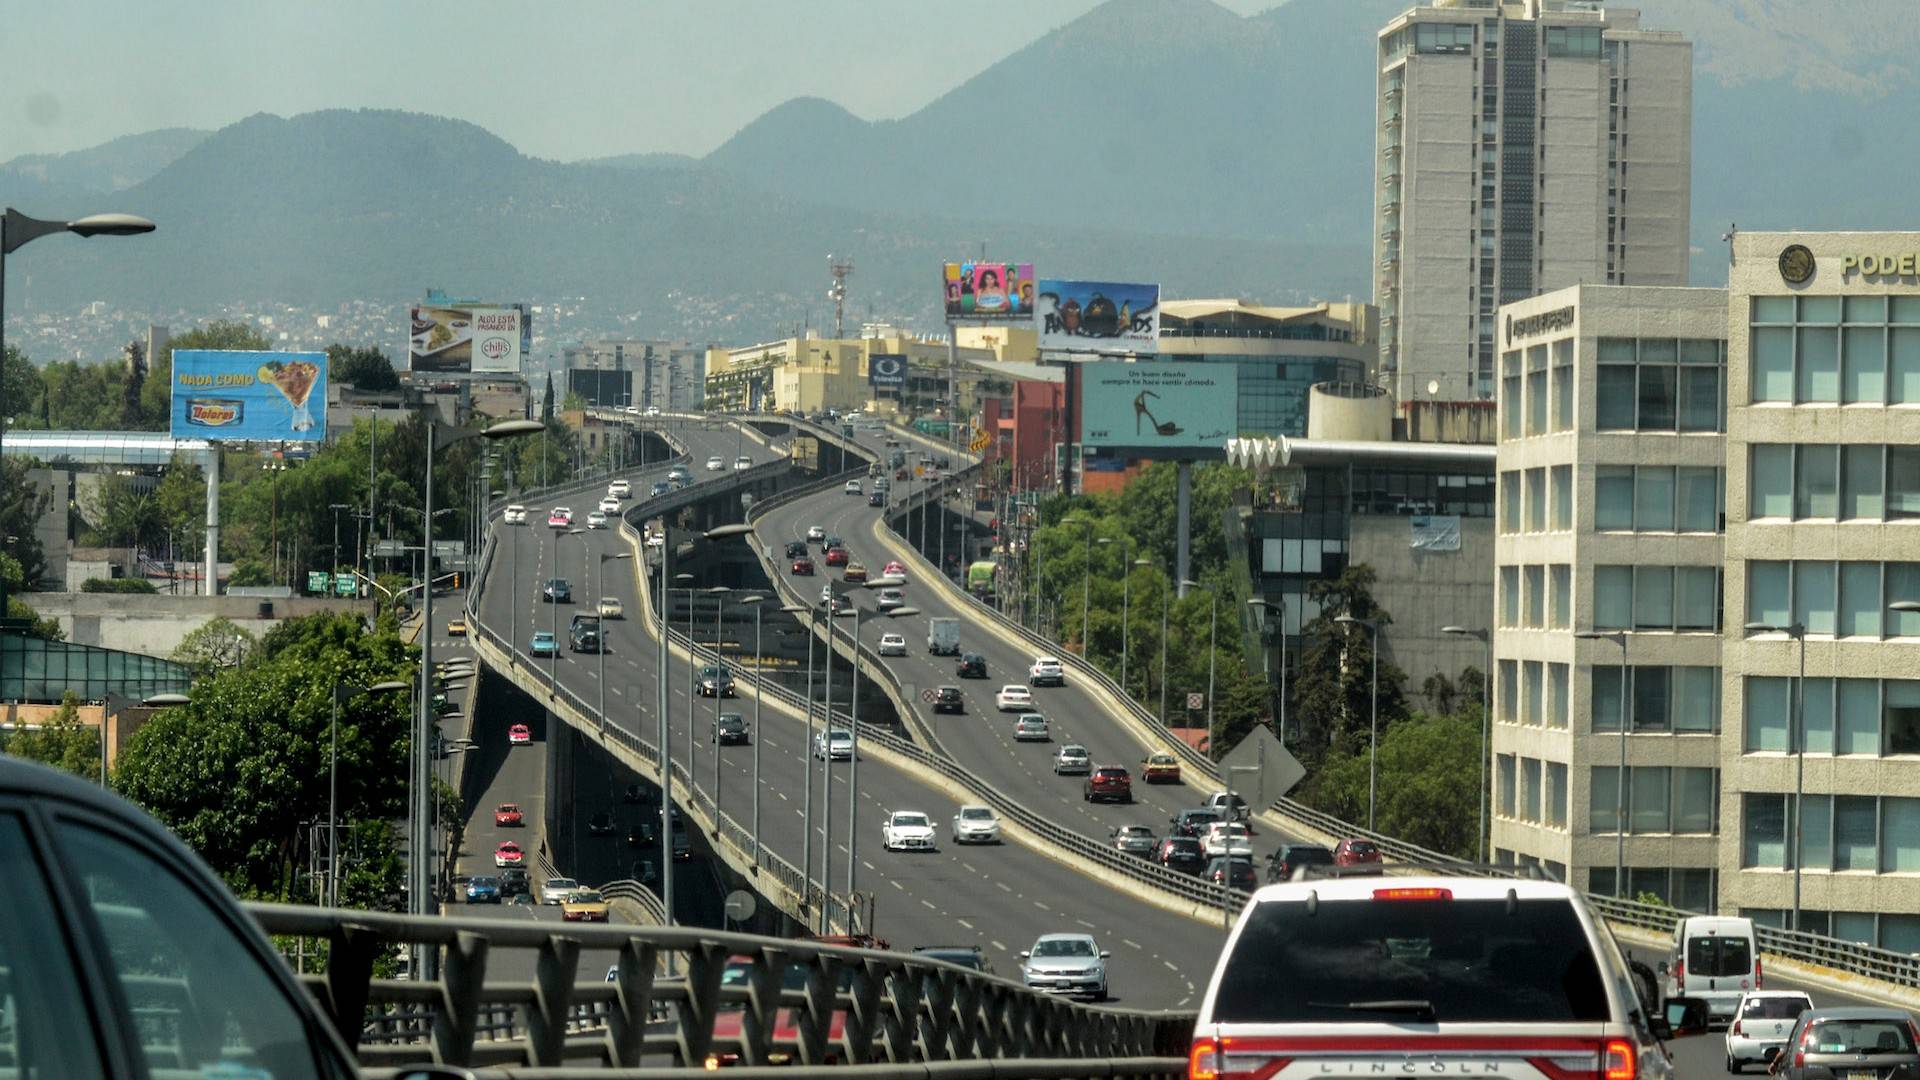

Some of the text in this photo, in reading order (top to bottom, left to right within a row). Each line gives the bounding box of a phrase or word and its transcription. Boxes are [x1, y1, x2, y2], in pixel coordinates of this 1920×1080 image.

[1841, 254, 1920, 276] PODE
[179, 373, 255, 386] NADA COMO
[192, 405, 236, 421] Dolores
[1320, 1063, 1499, 1073] LINCOLN
